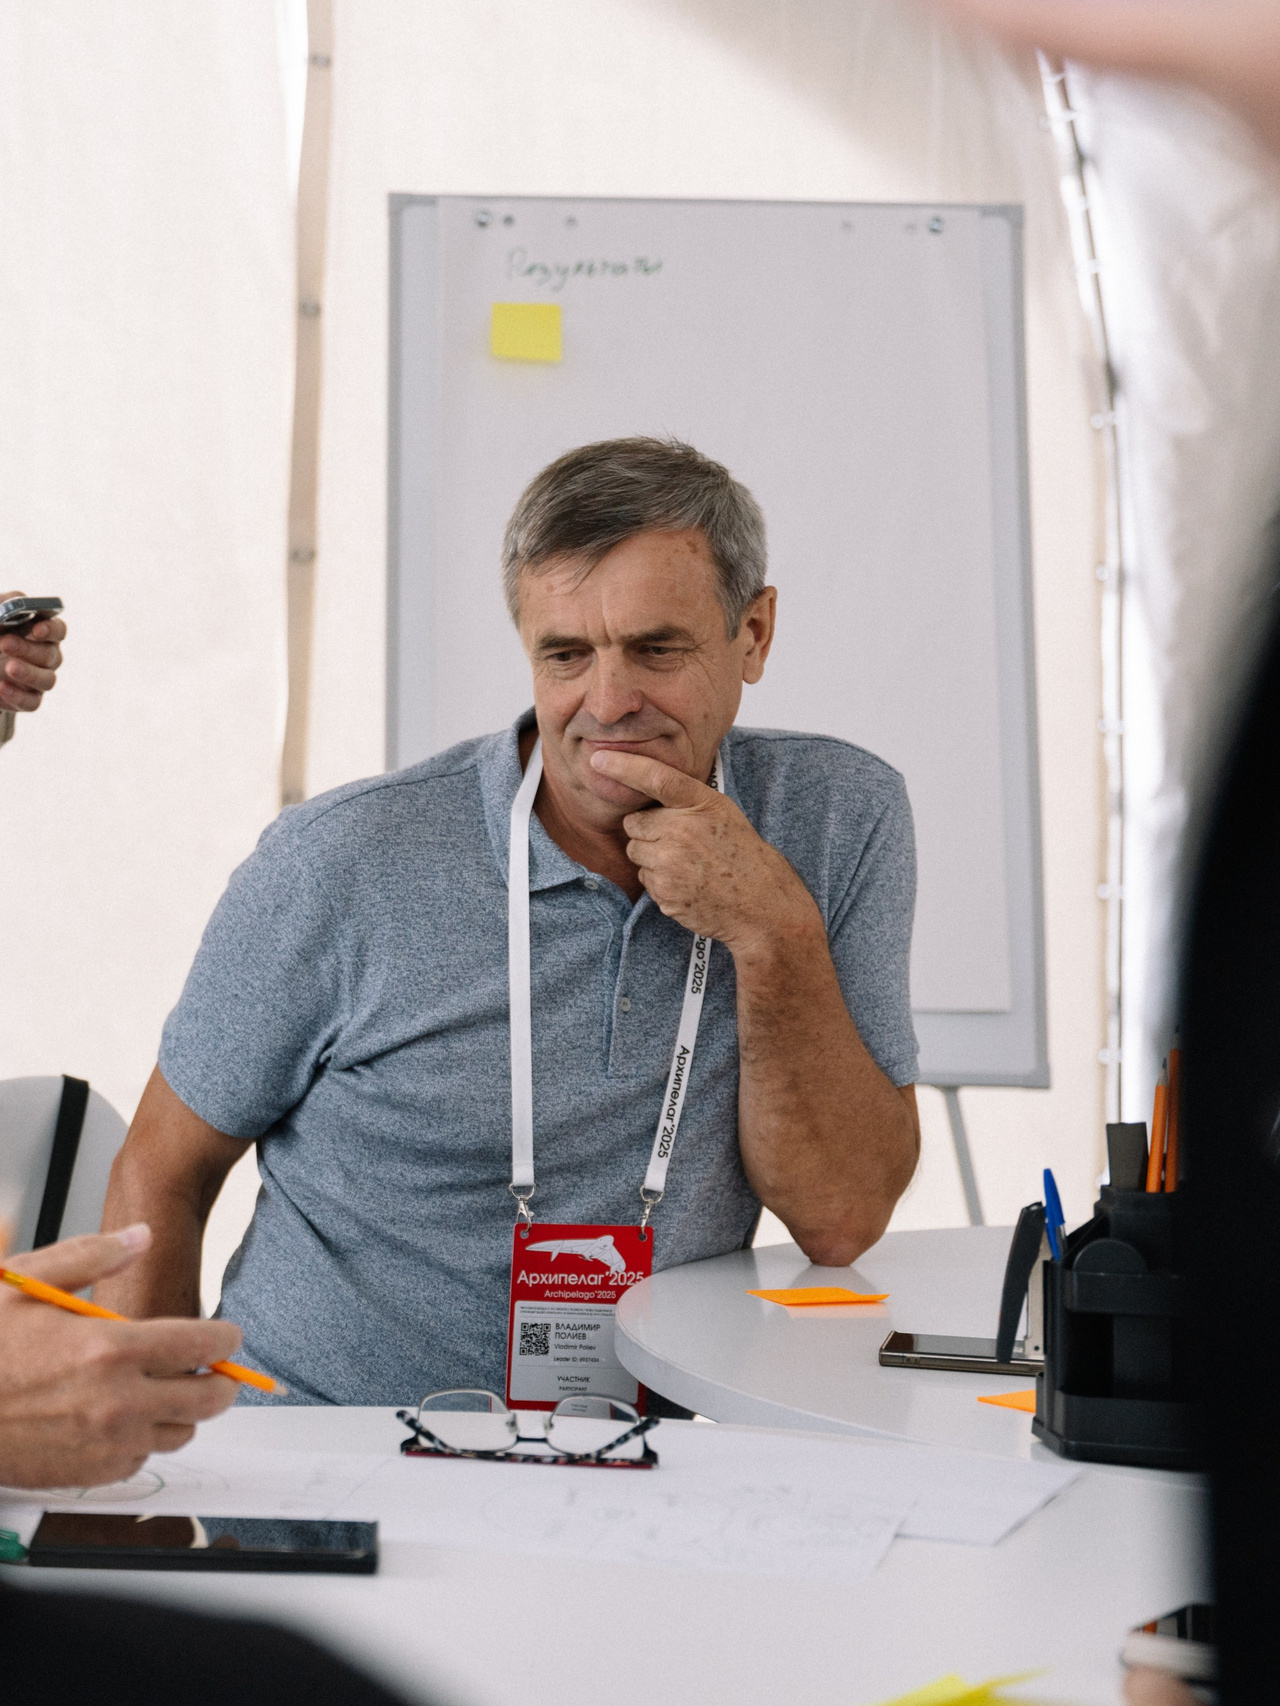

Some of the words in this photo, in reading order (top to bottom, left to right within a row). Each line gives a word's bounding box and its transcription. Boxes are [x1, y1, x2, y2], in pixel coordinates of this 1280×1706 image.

[658, 1045, 691, 1159] Архипелаг'2025
[555, 1322, 601, 1332] ВЛАДИМИР
[554, 1331, 587, 1340] ПОЛИЕВ
